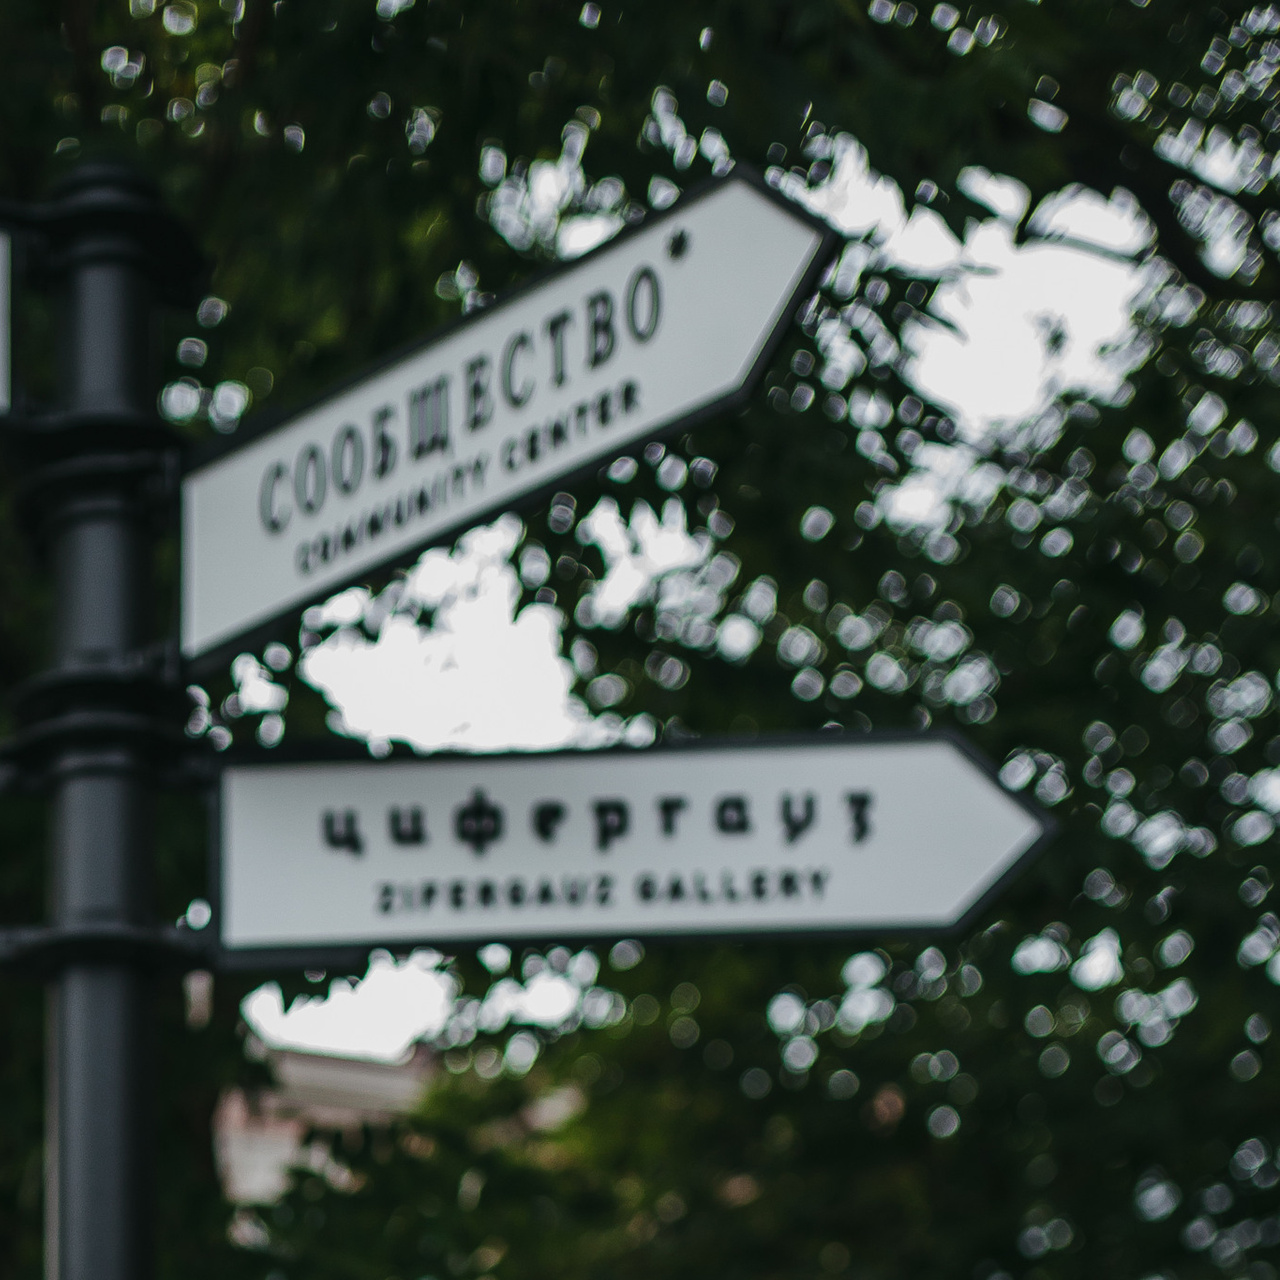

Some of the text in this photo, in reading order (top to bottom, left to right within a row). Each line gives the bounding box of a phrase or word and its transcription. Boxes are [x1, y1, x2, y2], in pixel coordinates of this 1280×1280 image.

[294, 379, 638, 577] COMMUNITY CENTER
[633, 867, 829, 905] GALLERY
